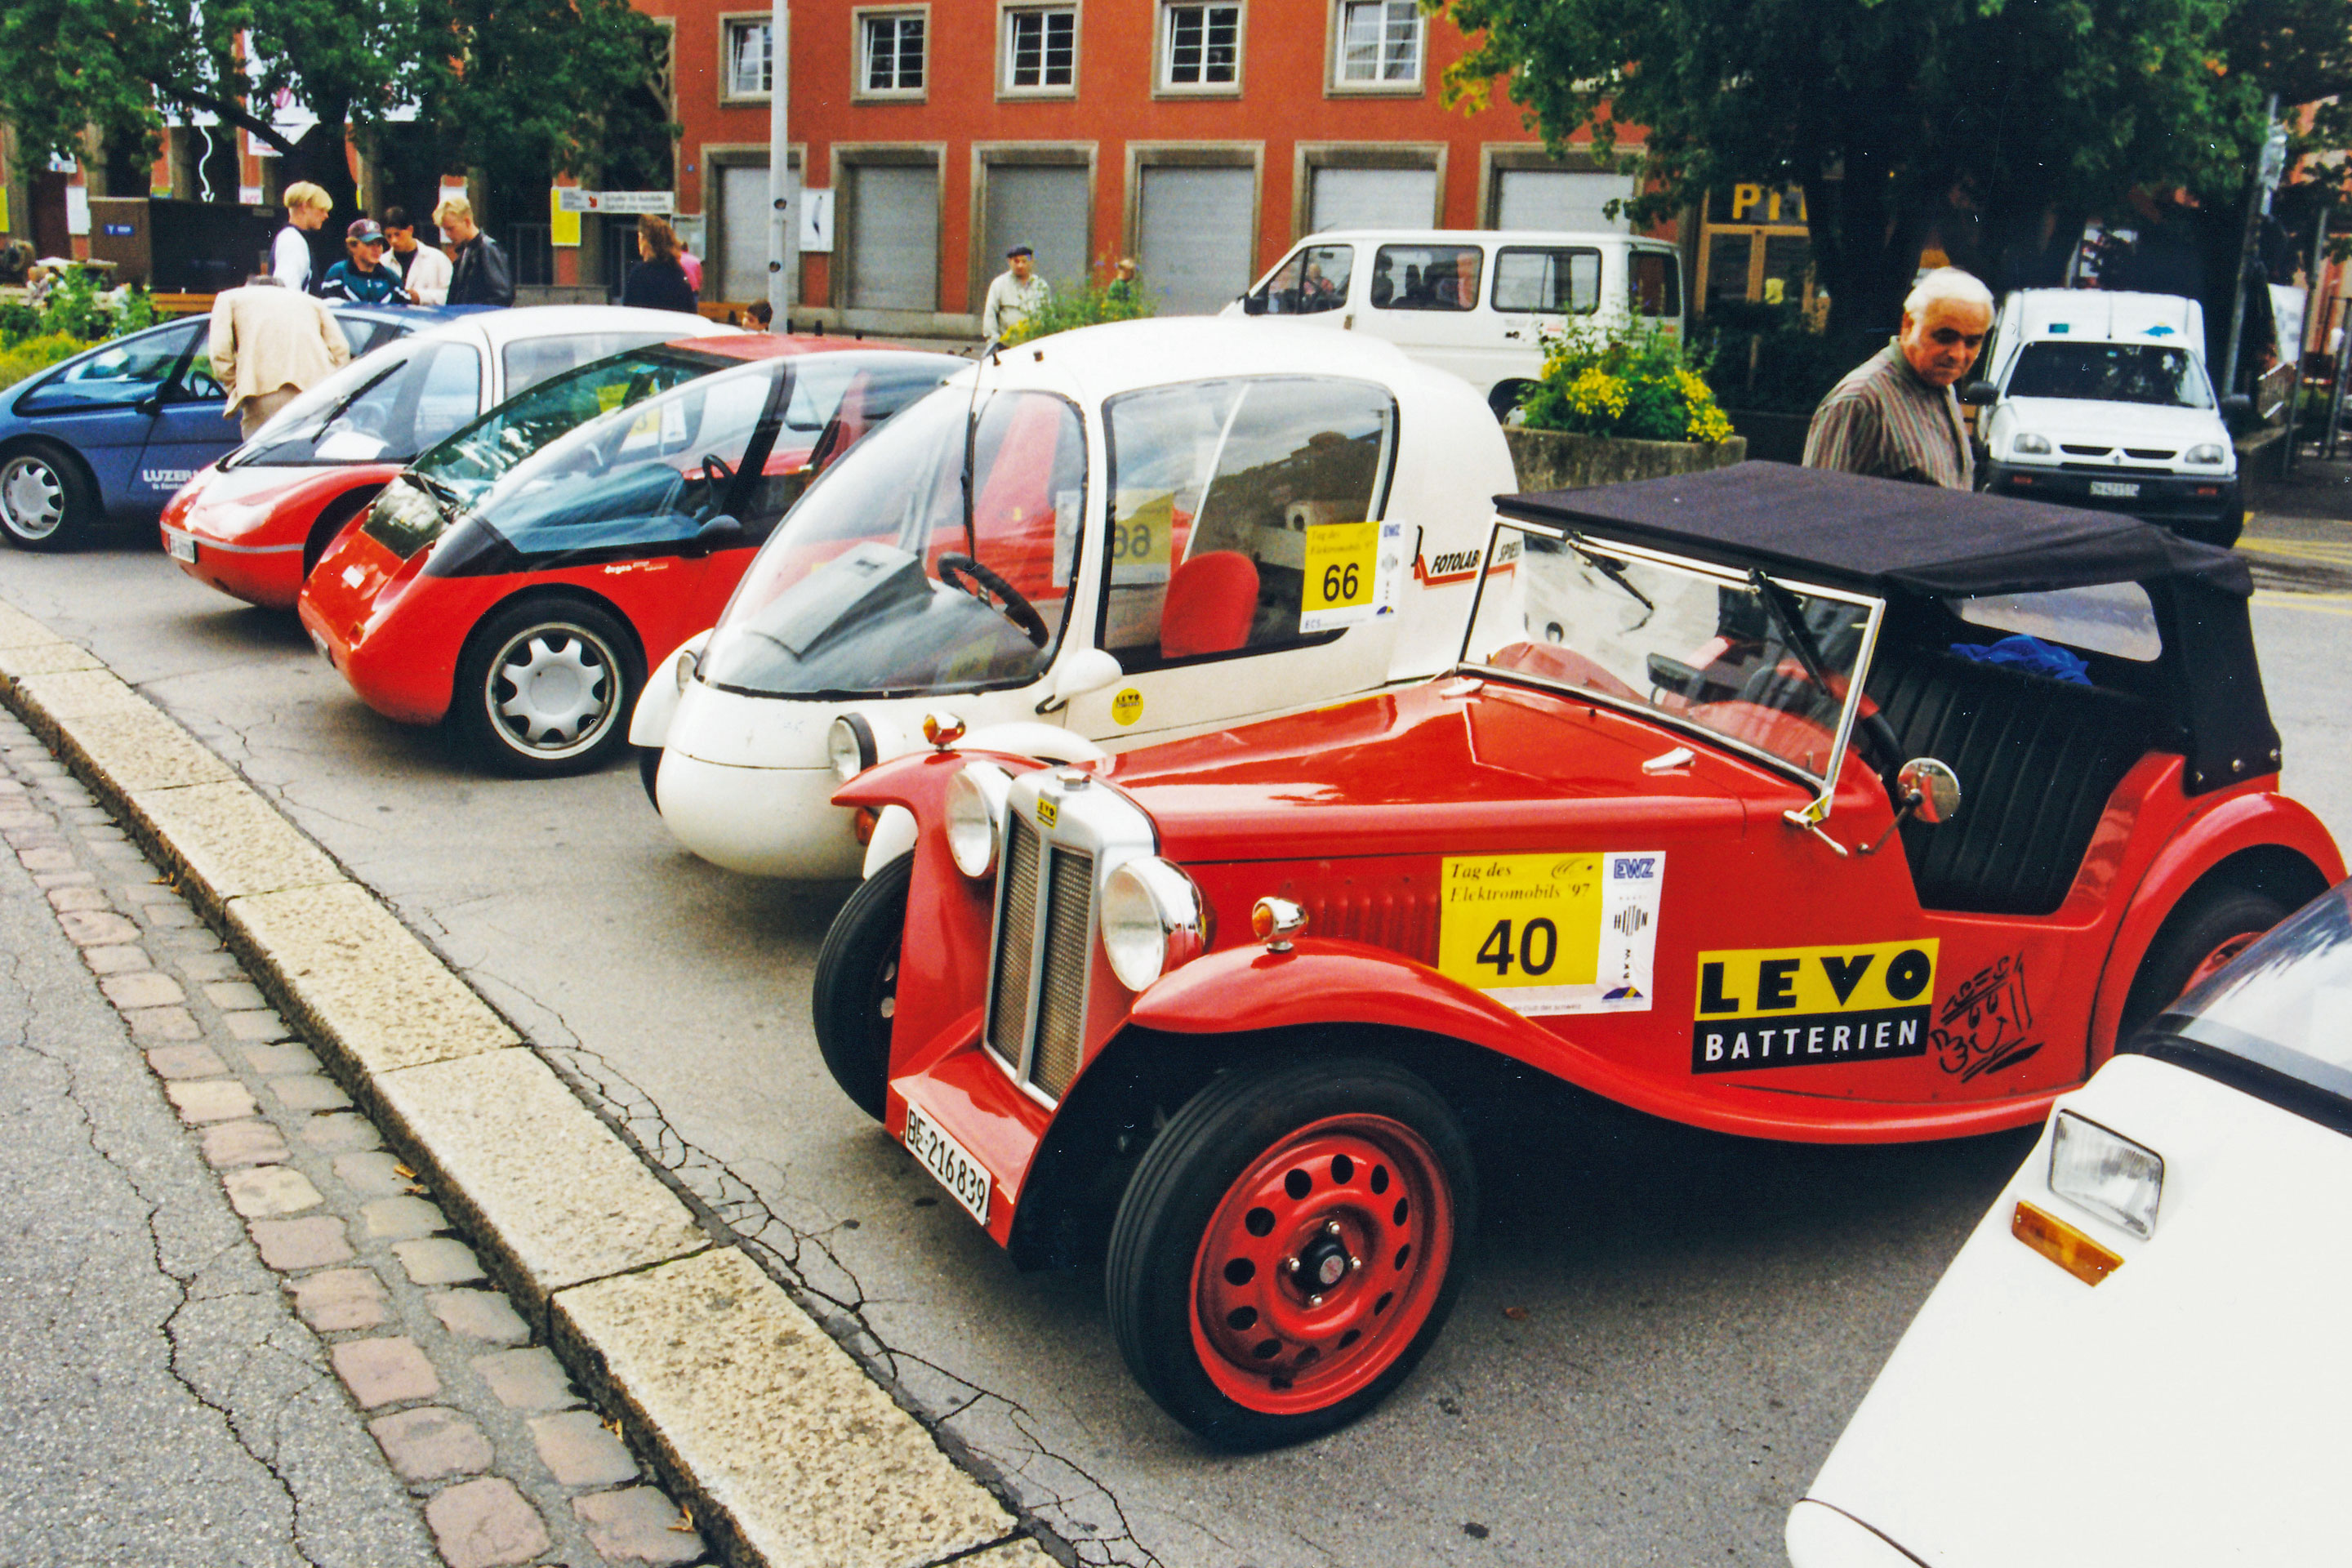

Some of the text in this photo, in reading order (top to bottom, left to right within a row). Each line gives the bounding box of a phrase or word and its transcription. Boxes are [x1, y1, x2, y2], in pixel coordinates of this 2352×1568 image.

[1323, 562, 1359, 602] 66
[1451, 862, 1512, 880] Tag des
[1614, 858, 1655, 880] EWZ
[1450, 883, 1590, 902] Elektromobils '97
[1476, 917, 1557, 976] 40
[1699, 949, 1931, 1014] LEVO
[1704, 1019, 1918, 1062] BATTERIEN
